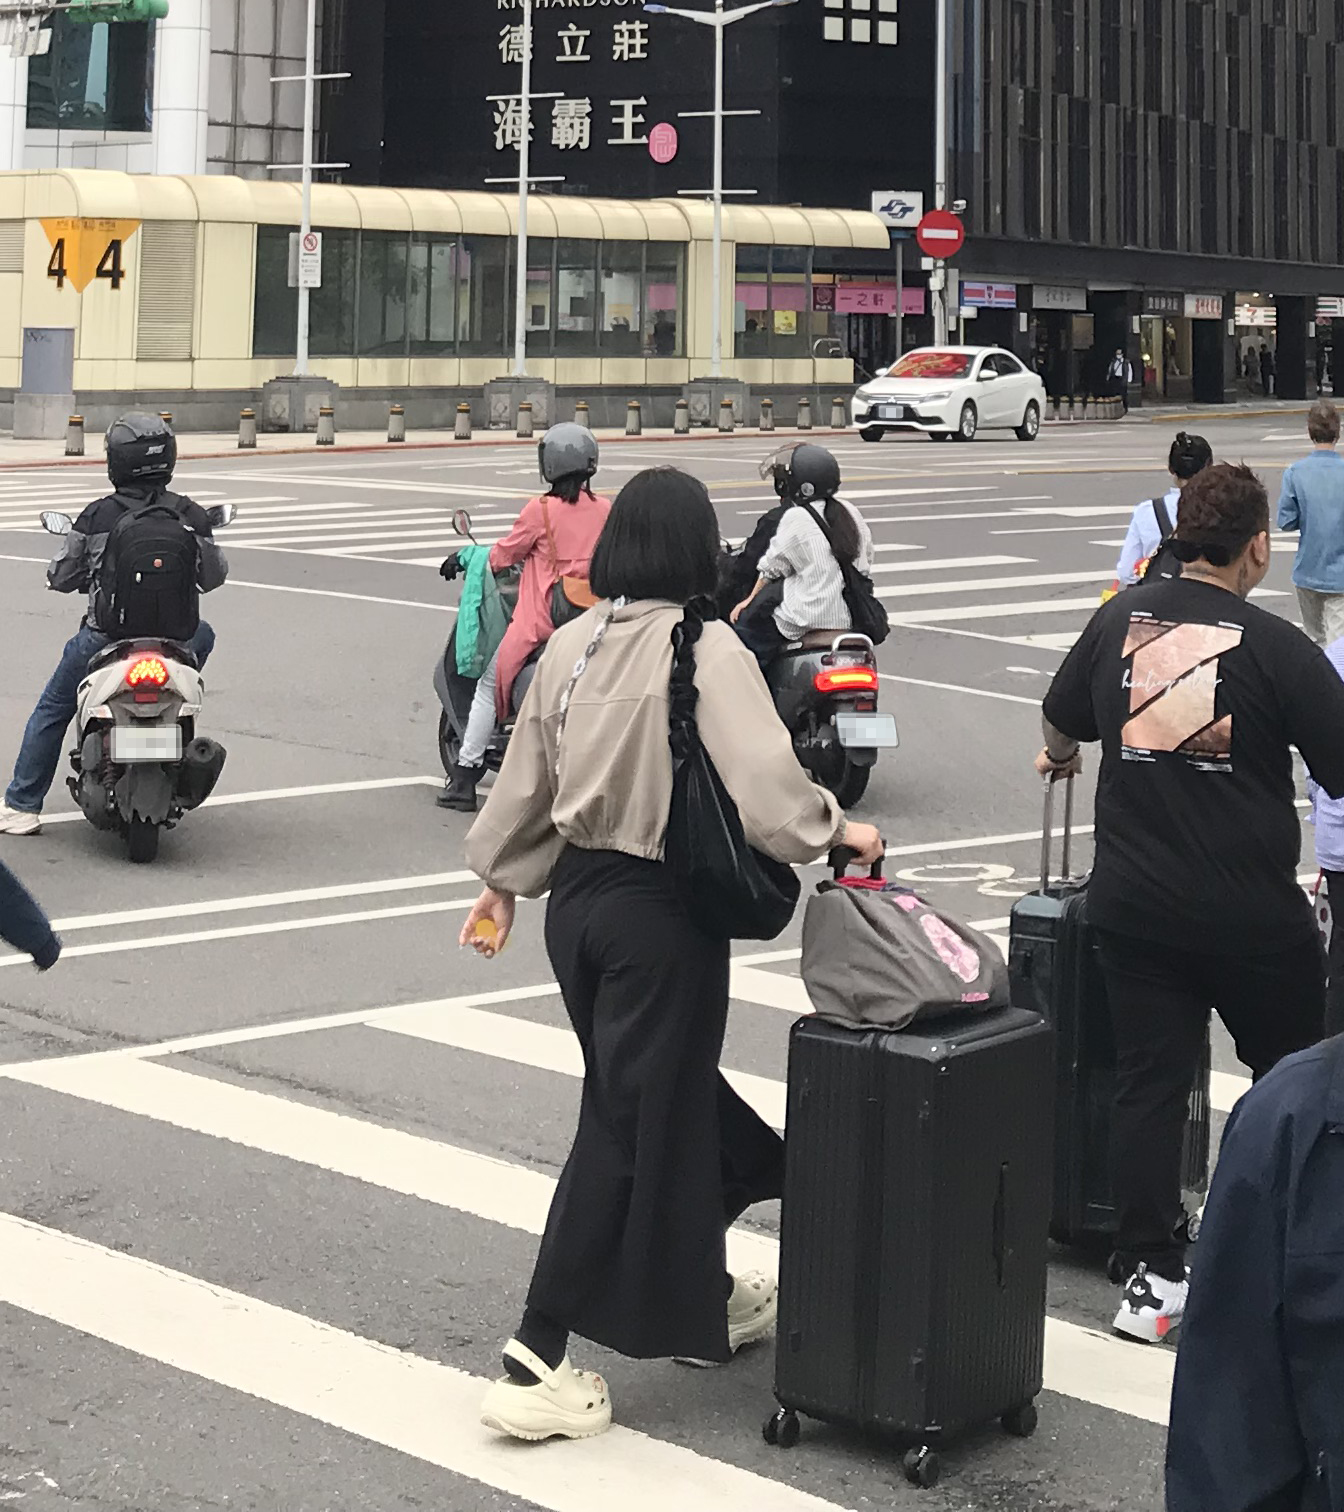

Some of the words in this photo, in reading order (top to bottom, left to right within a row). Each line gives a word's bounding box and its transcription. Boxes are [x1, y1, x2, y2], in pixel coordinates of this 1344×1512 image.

[498, 20, 650, 65] 德立莊
[493, 95, 649, 152] 海霸王
[47, 238, 67, 289] 4
[96, 239, 126, 290] 4
